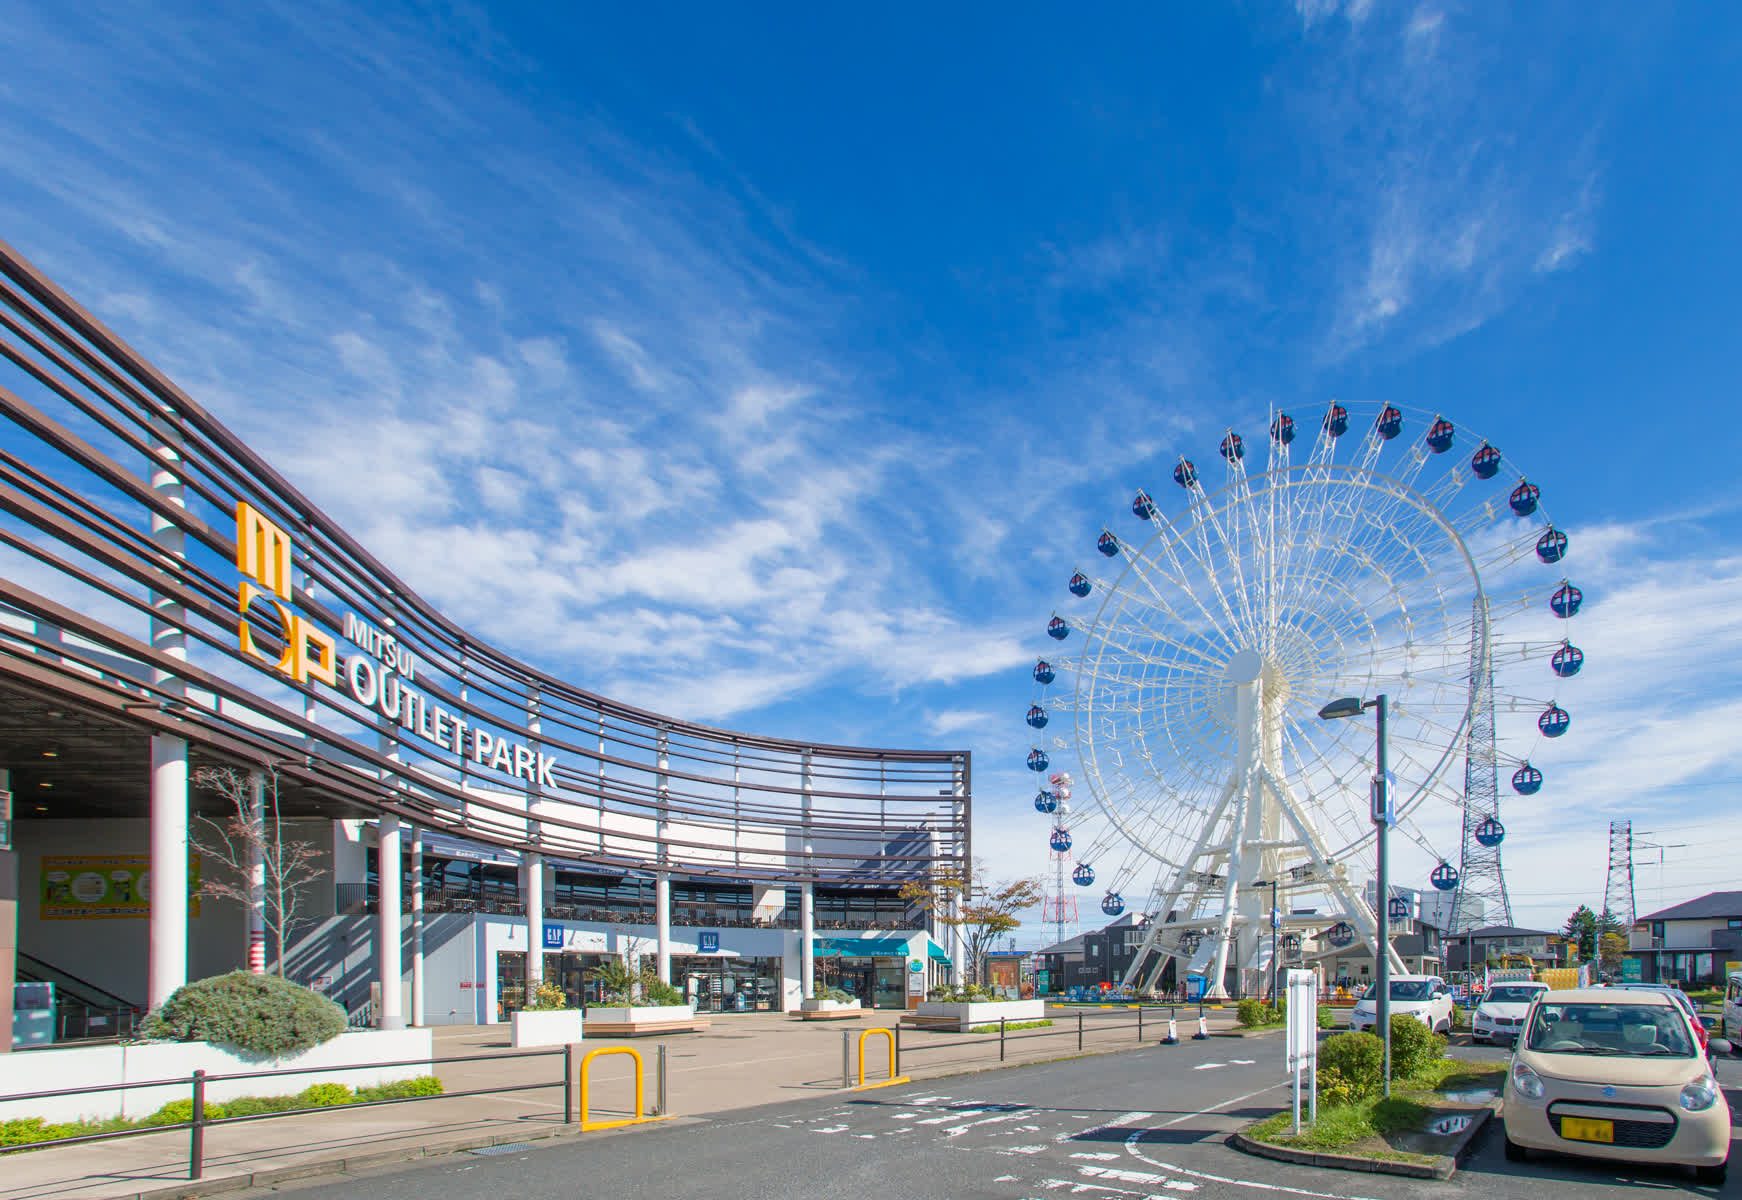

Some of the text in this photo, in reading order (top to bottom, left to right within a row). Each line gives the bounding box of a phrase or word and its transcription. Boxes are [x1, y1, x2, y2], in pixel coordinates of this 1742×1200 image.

[344, 611, 415, 681] MITSUI
[344, 655, 558, 789] OUTLET PARK
[547, 928, 562, 940] GAP
